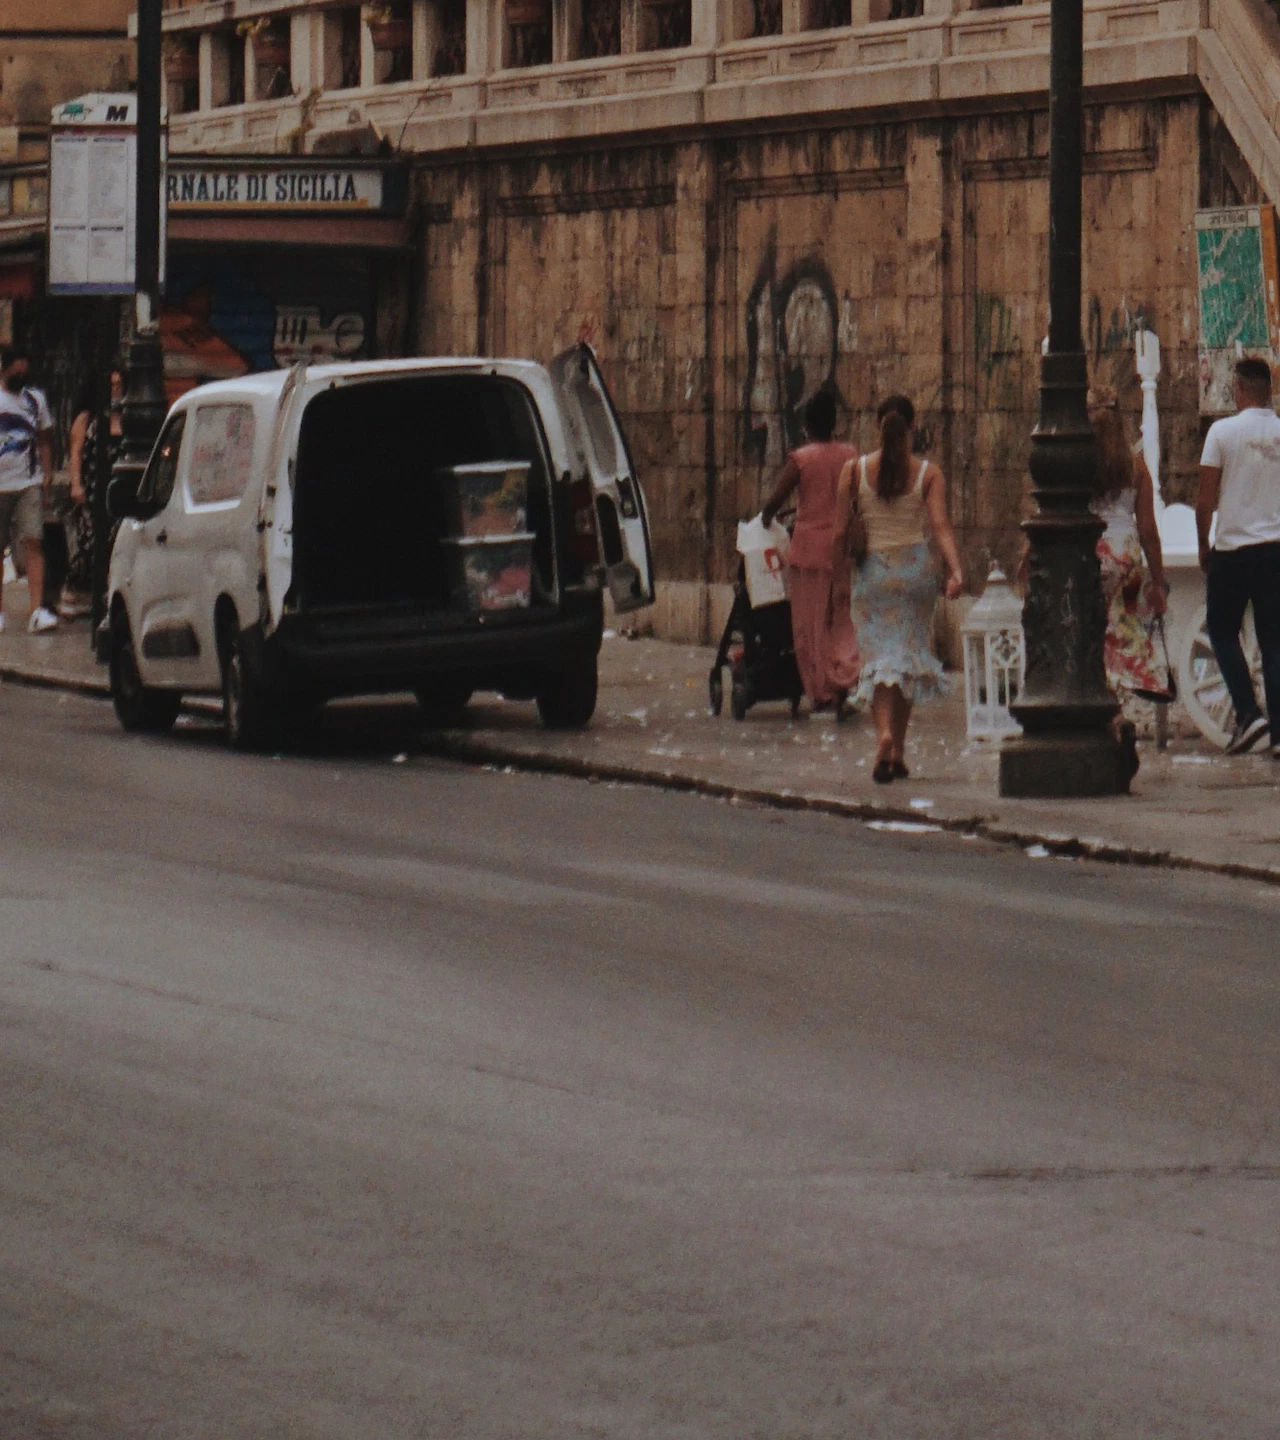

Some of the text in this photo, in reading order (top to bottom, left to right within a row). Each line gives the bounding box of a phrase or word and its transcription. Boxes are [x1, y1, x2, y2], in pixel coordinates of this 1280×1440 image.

[167, 168, 359, 202] RNALE DI SICILIA
